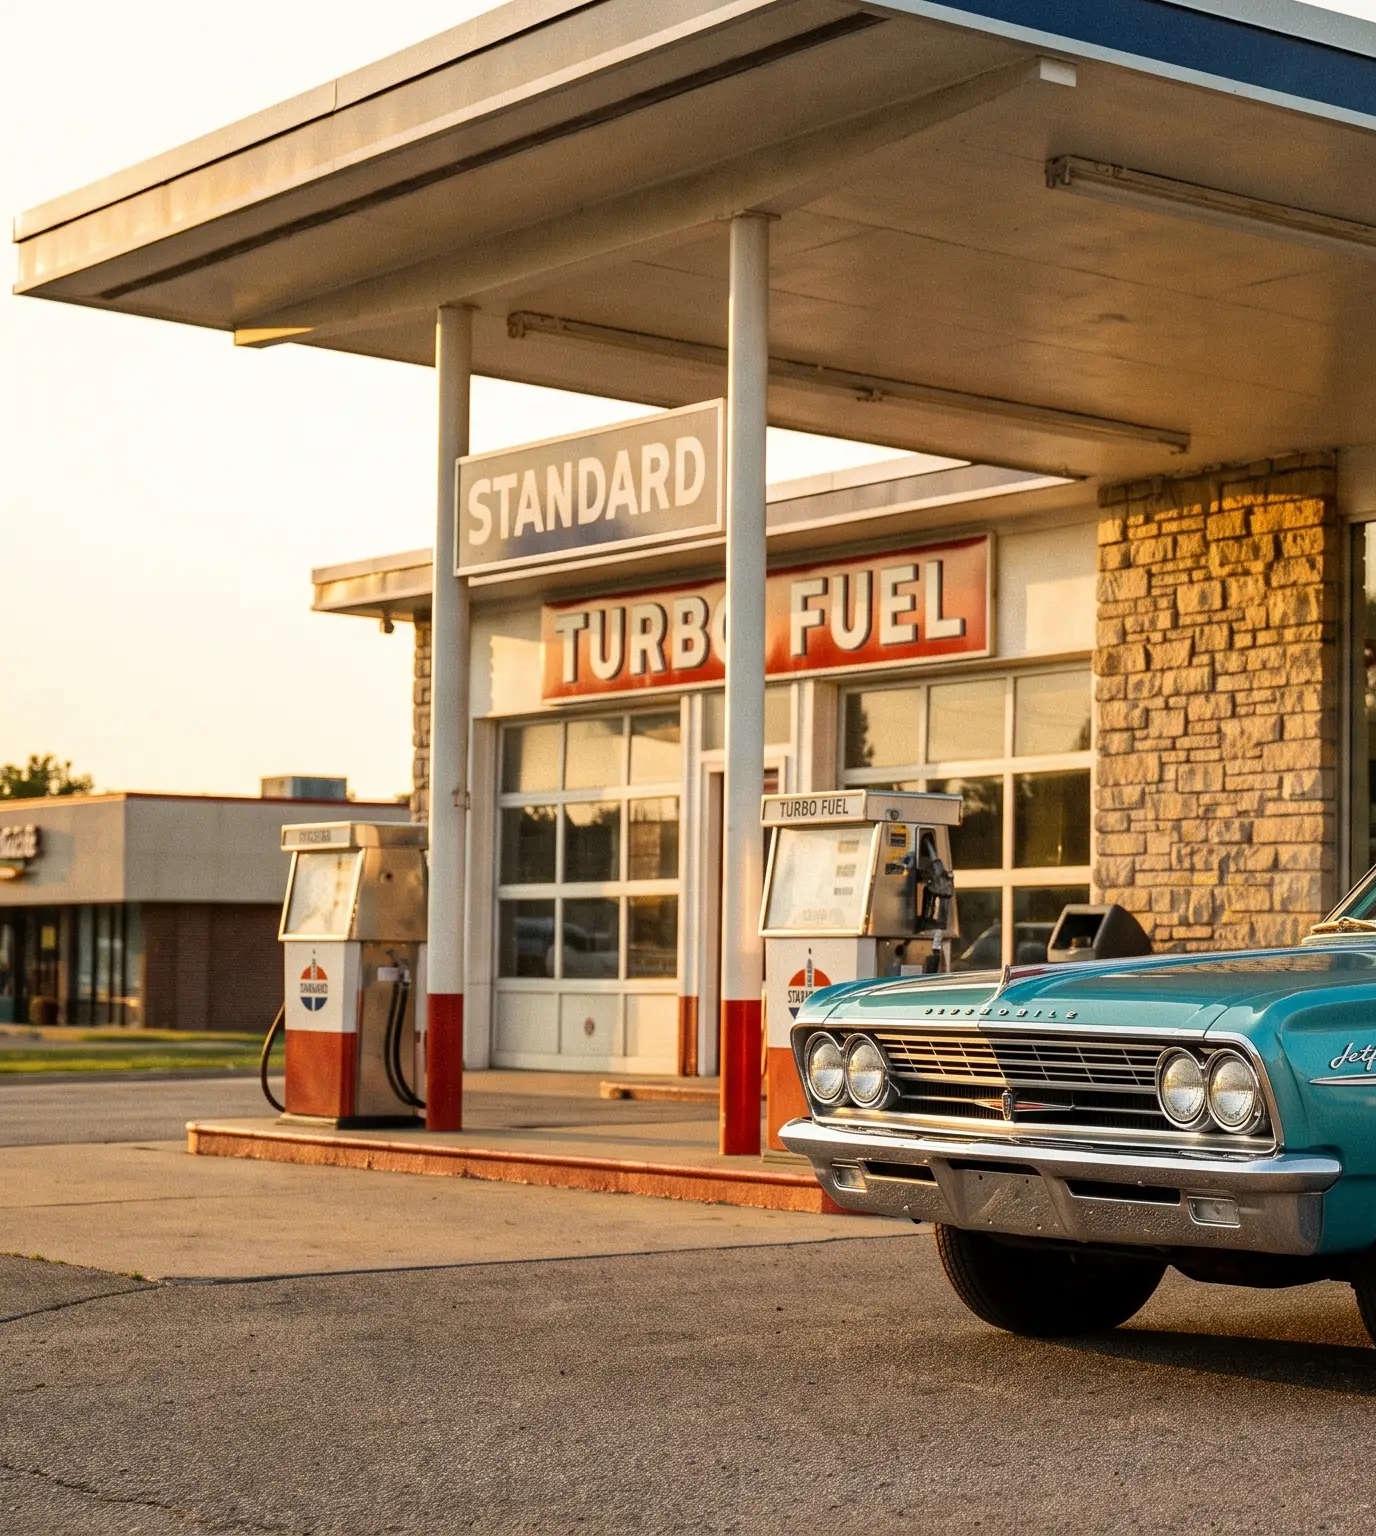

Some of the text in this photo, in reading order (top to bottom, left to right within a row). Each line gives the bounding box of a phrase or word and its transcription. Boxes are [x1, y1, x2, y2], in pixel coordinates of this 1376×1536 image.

[467, 435, 706, 546] STANDARD
[790, 559, 966, 658] FUEL
[779, 798, 849, 818] TURBO FUEL
